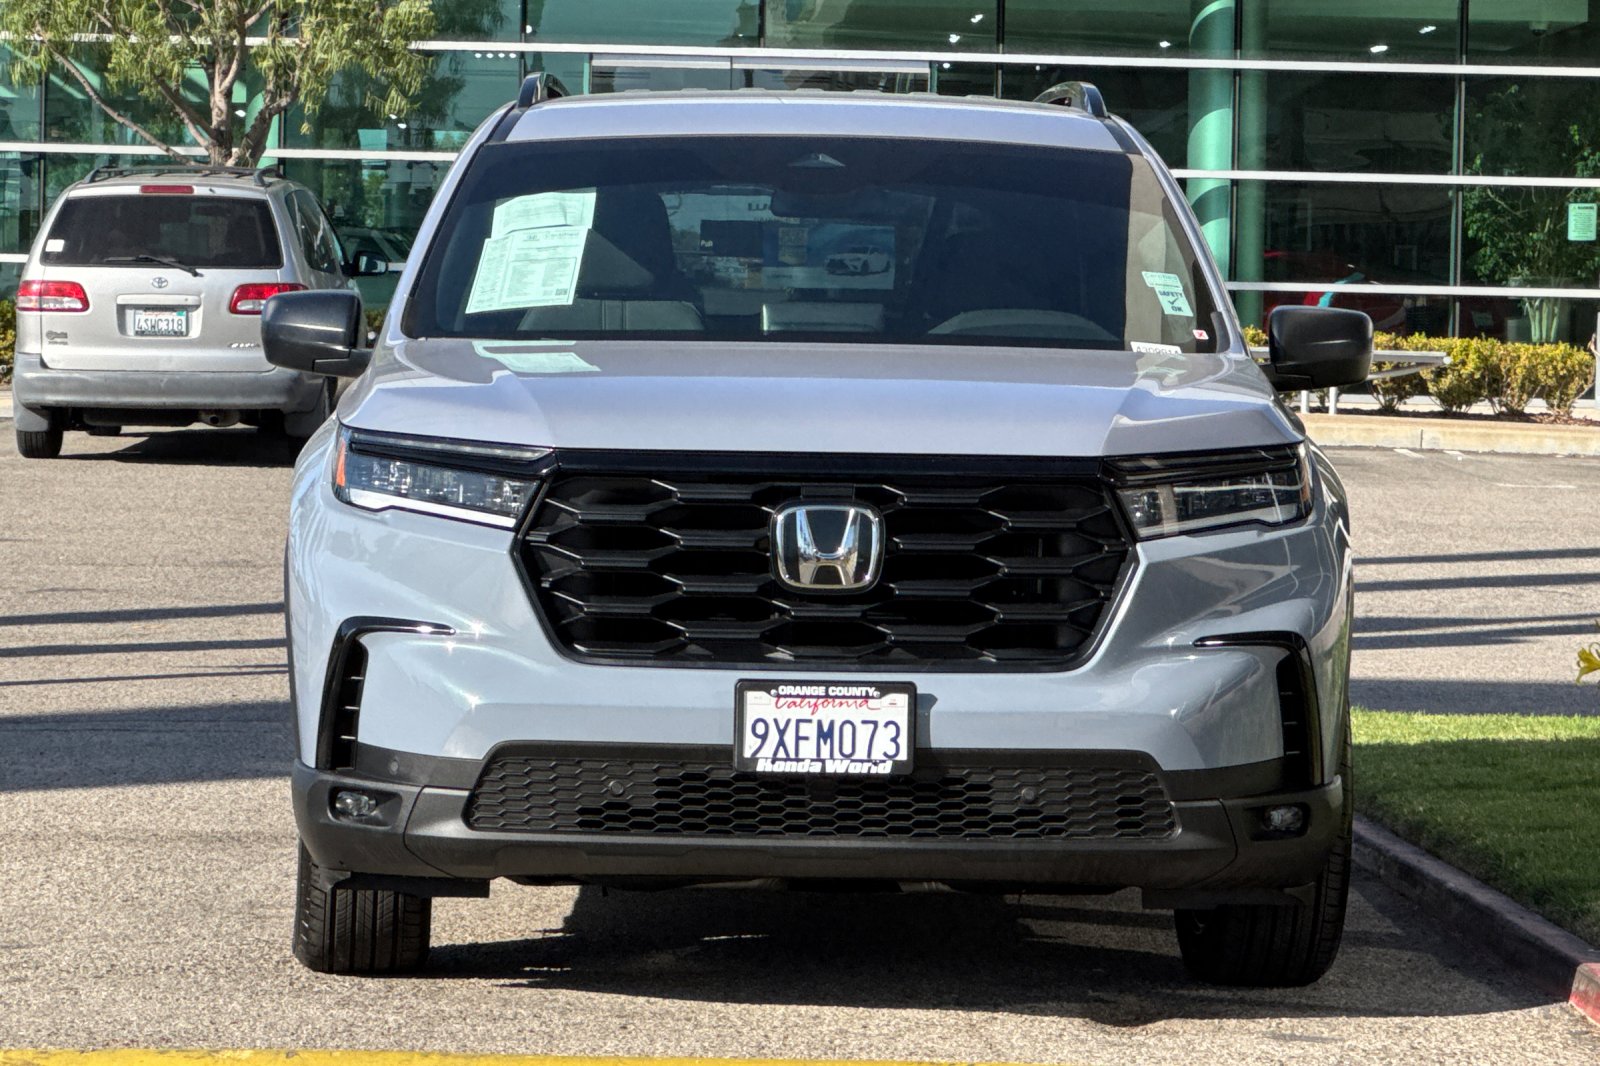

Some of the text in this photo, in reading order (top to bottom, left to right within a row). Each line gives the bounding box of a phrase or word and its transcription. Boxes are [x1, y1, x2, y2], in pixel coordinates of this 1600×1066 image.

[778, 685, 875, 697] ORANGE COUNTY
[774, 695, 881, 716] California
[750, 717, 901, 760] 9XFM073
[756, 758, 893, 774] Honda World
